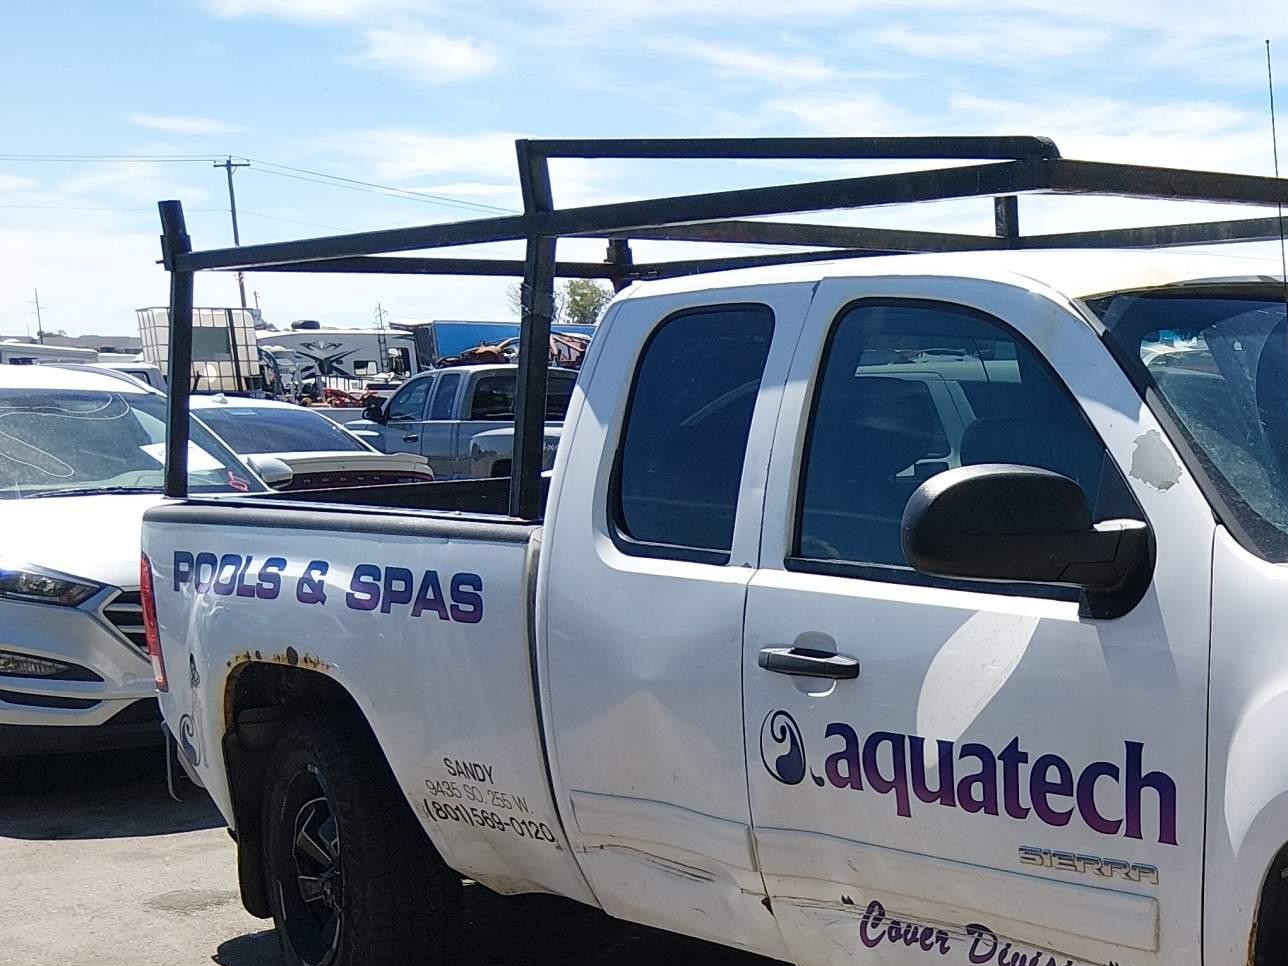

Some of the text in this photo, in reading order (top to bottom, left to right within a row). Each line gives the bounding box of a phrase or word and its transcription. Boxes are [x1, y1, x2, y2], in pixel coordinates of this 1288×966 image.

[173, 550, 484, 624] POOLS & SPAS
[443, 757, 494, 785] SANDY
[823, 721, 1179, 846] aquatech
[425, 779, 462, 799] 9435
[487, 788, 513, 811] 255
[511, 794, 534, 815] W.
[423, 798, 555, 843] (801)569-0120
[1017, 845, 1160, 886] SIERRA
